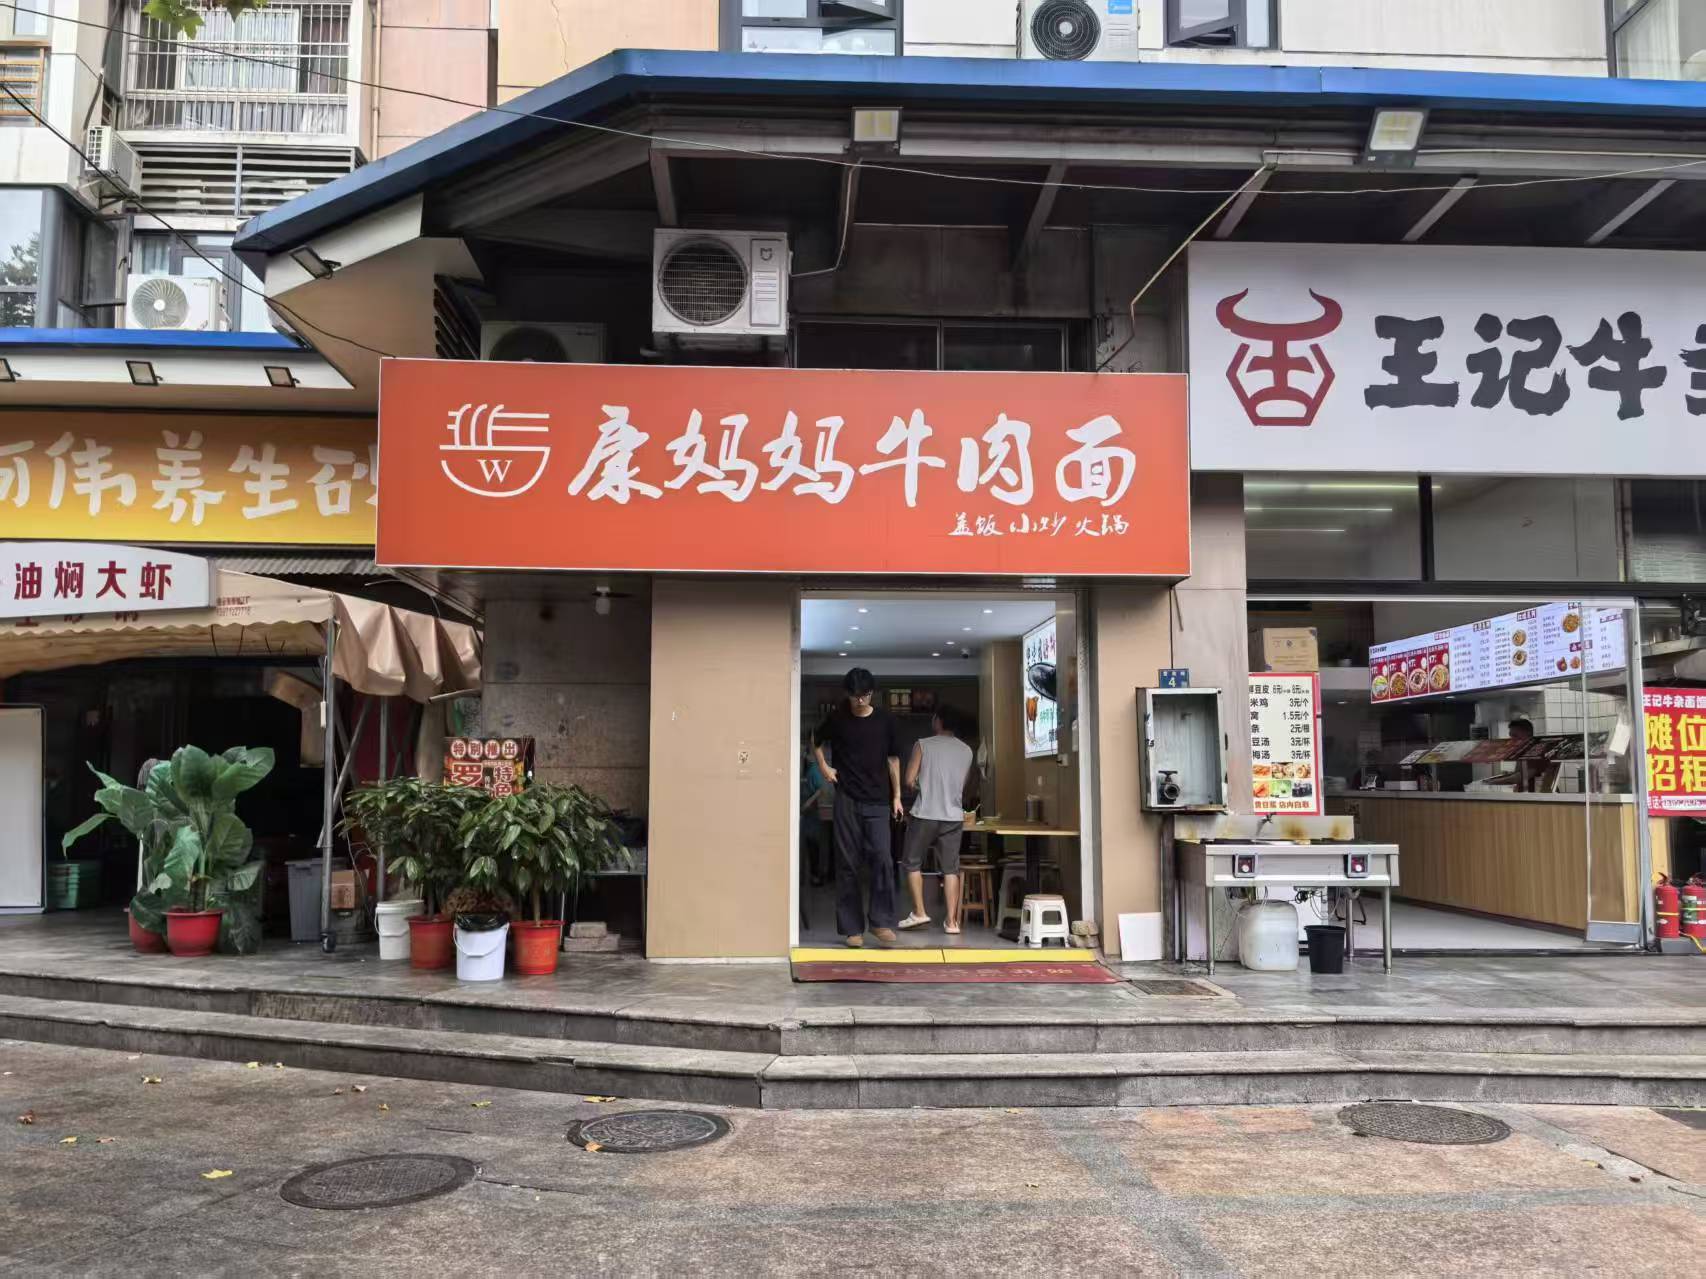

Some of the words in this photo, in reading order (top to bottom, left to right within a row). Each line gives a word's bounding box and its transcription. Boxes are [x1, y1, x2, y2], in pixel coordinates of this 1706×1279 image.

[477, 458, 513, 484] W
[567, 404, 1136, 507] 康妈妈牛肉面
[948, 512, 1004, 537] 盖饭
[1009, 512, 1067, 537] 小炒
[1075, 512, 1130, 537] 火锅
[14, 559, 172, 601] 油焖大虾
[1289, 698, 1309, 707] 3元/个
[1645, 712, 1706, 752] 摊位
[1647, 754, 1706, 792] 招租
